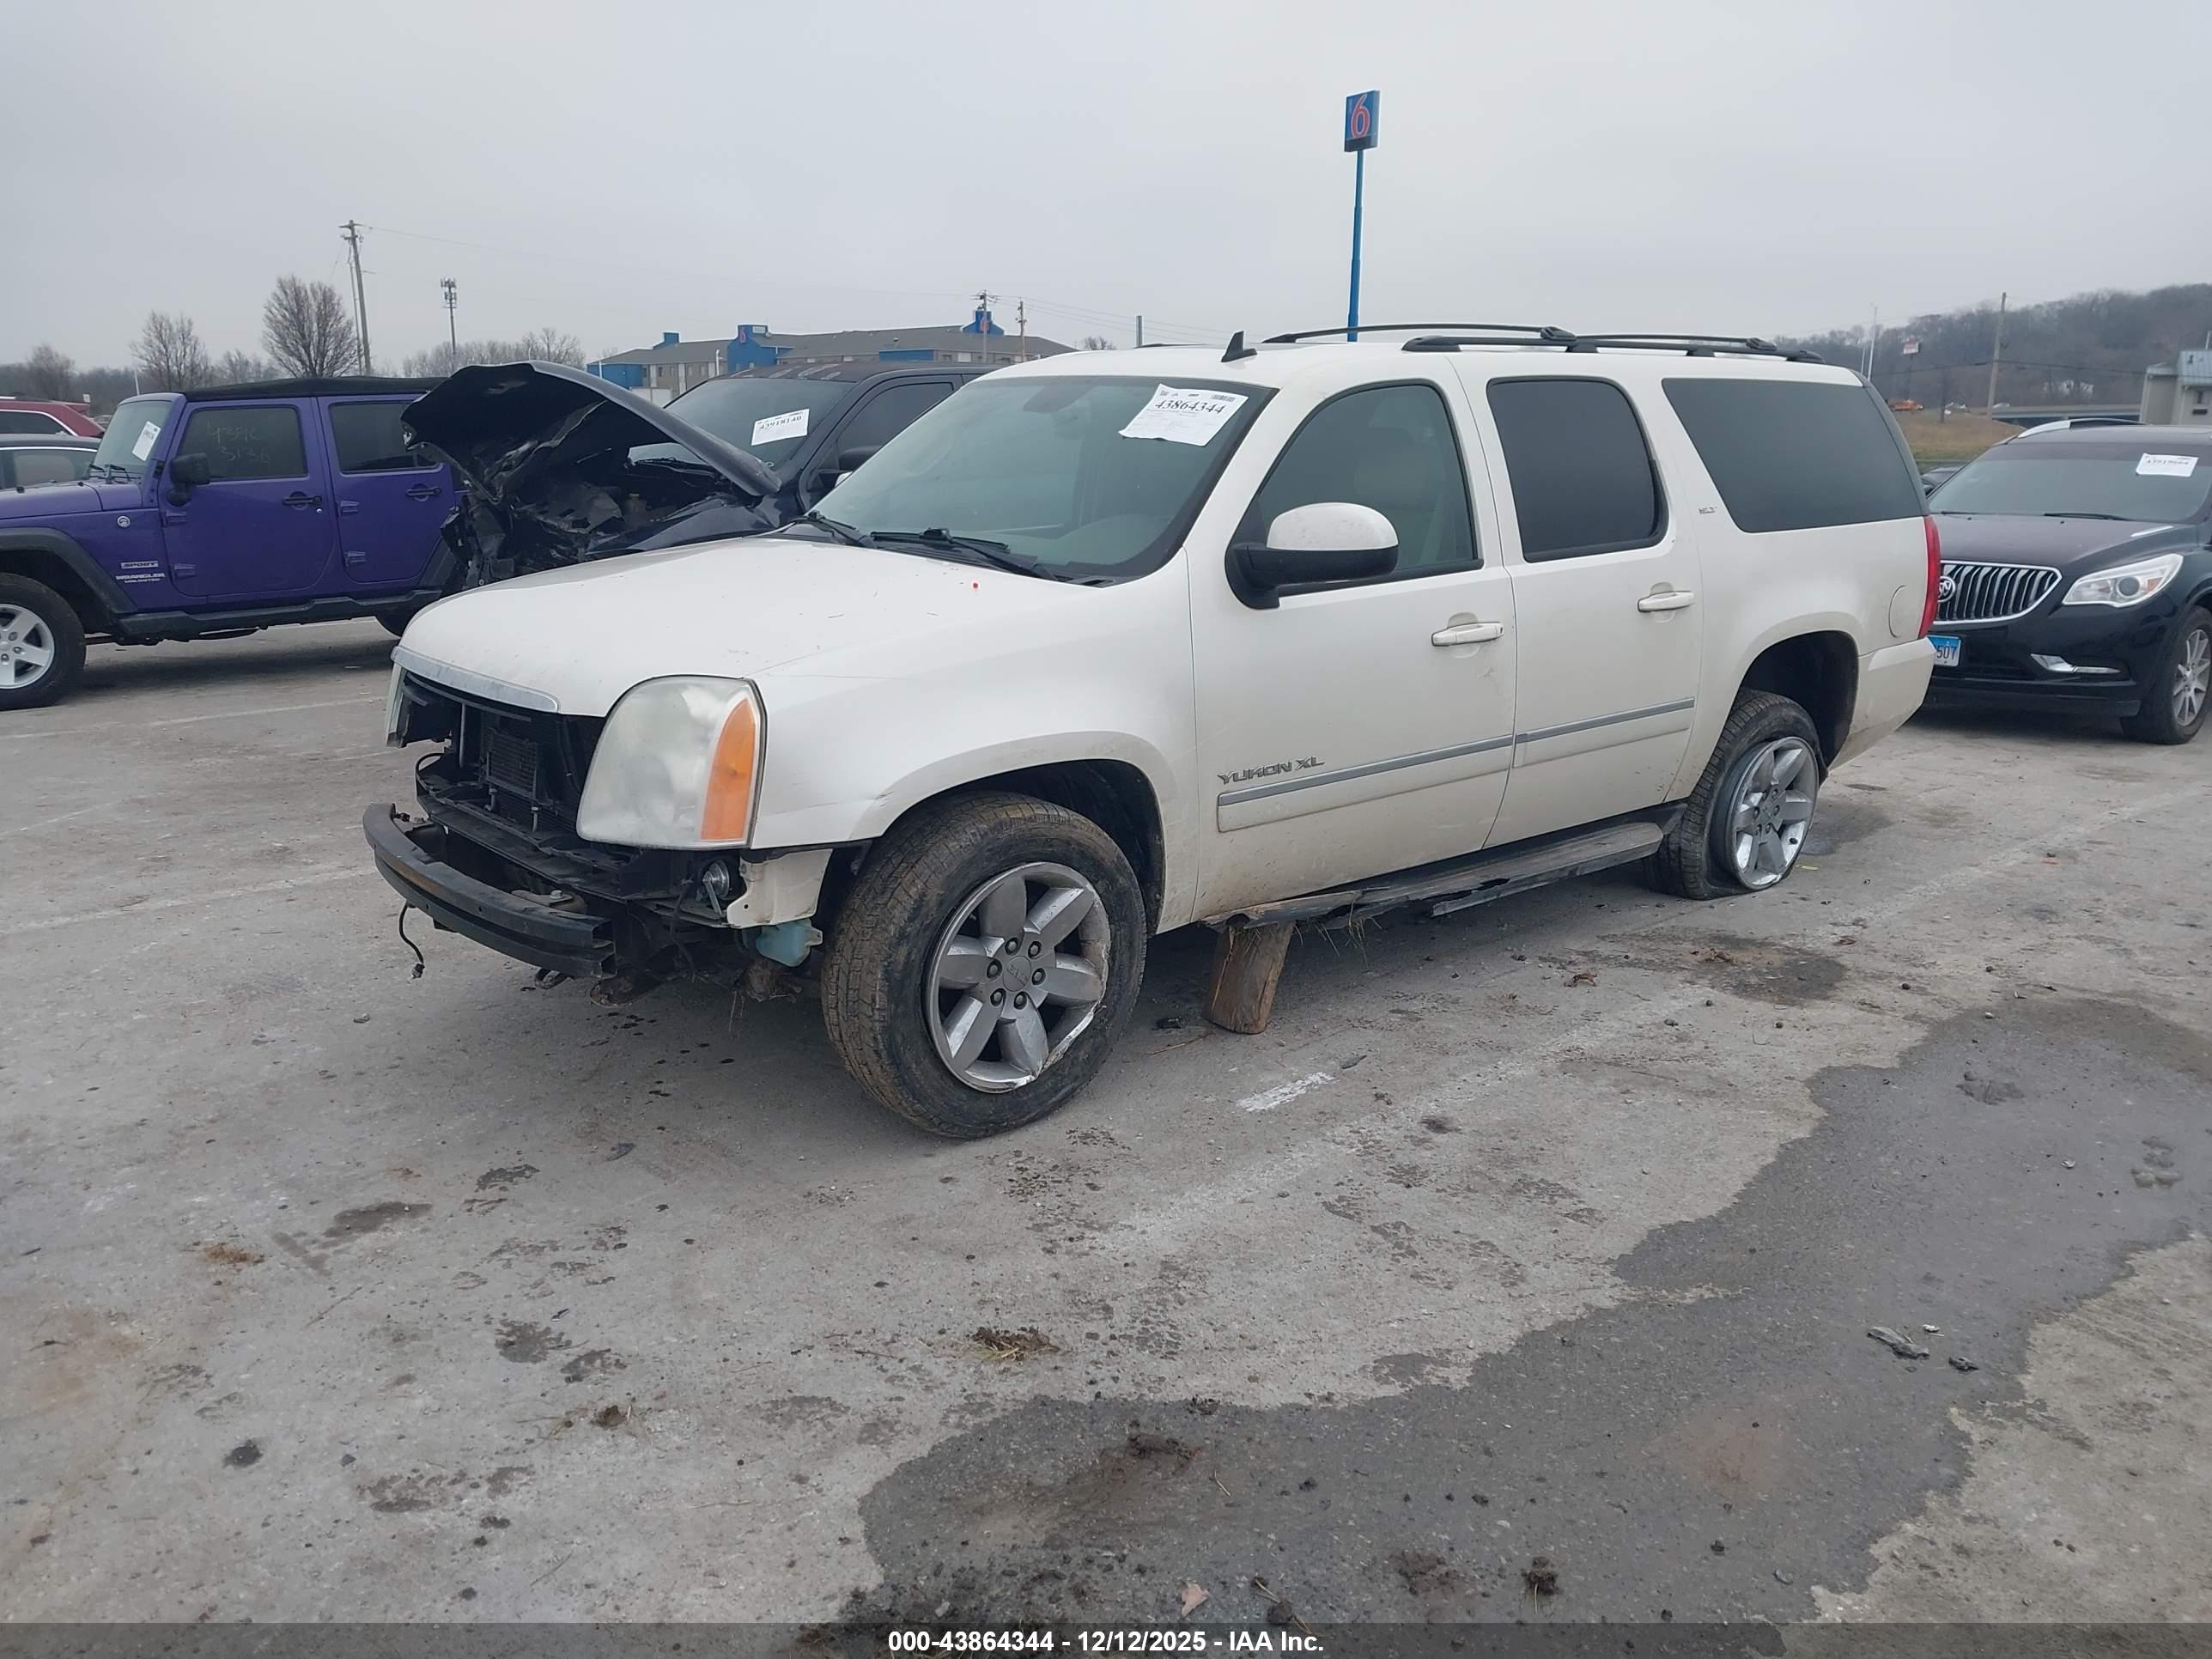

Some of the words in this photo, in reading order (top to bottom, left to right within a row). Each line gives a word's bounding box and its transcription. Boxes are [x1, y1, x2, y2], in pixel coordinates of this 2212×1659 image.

[1351, 94, 1370, 139] 6
[1154, 399, 1226, 414] 43864344
[1217, 762, 1292, 785] YUKON
[1295, 757, 1325, 771] XL
